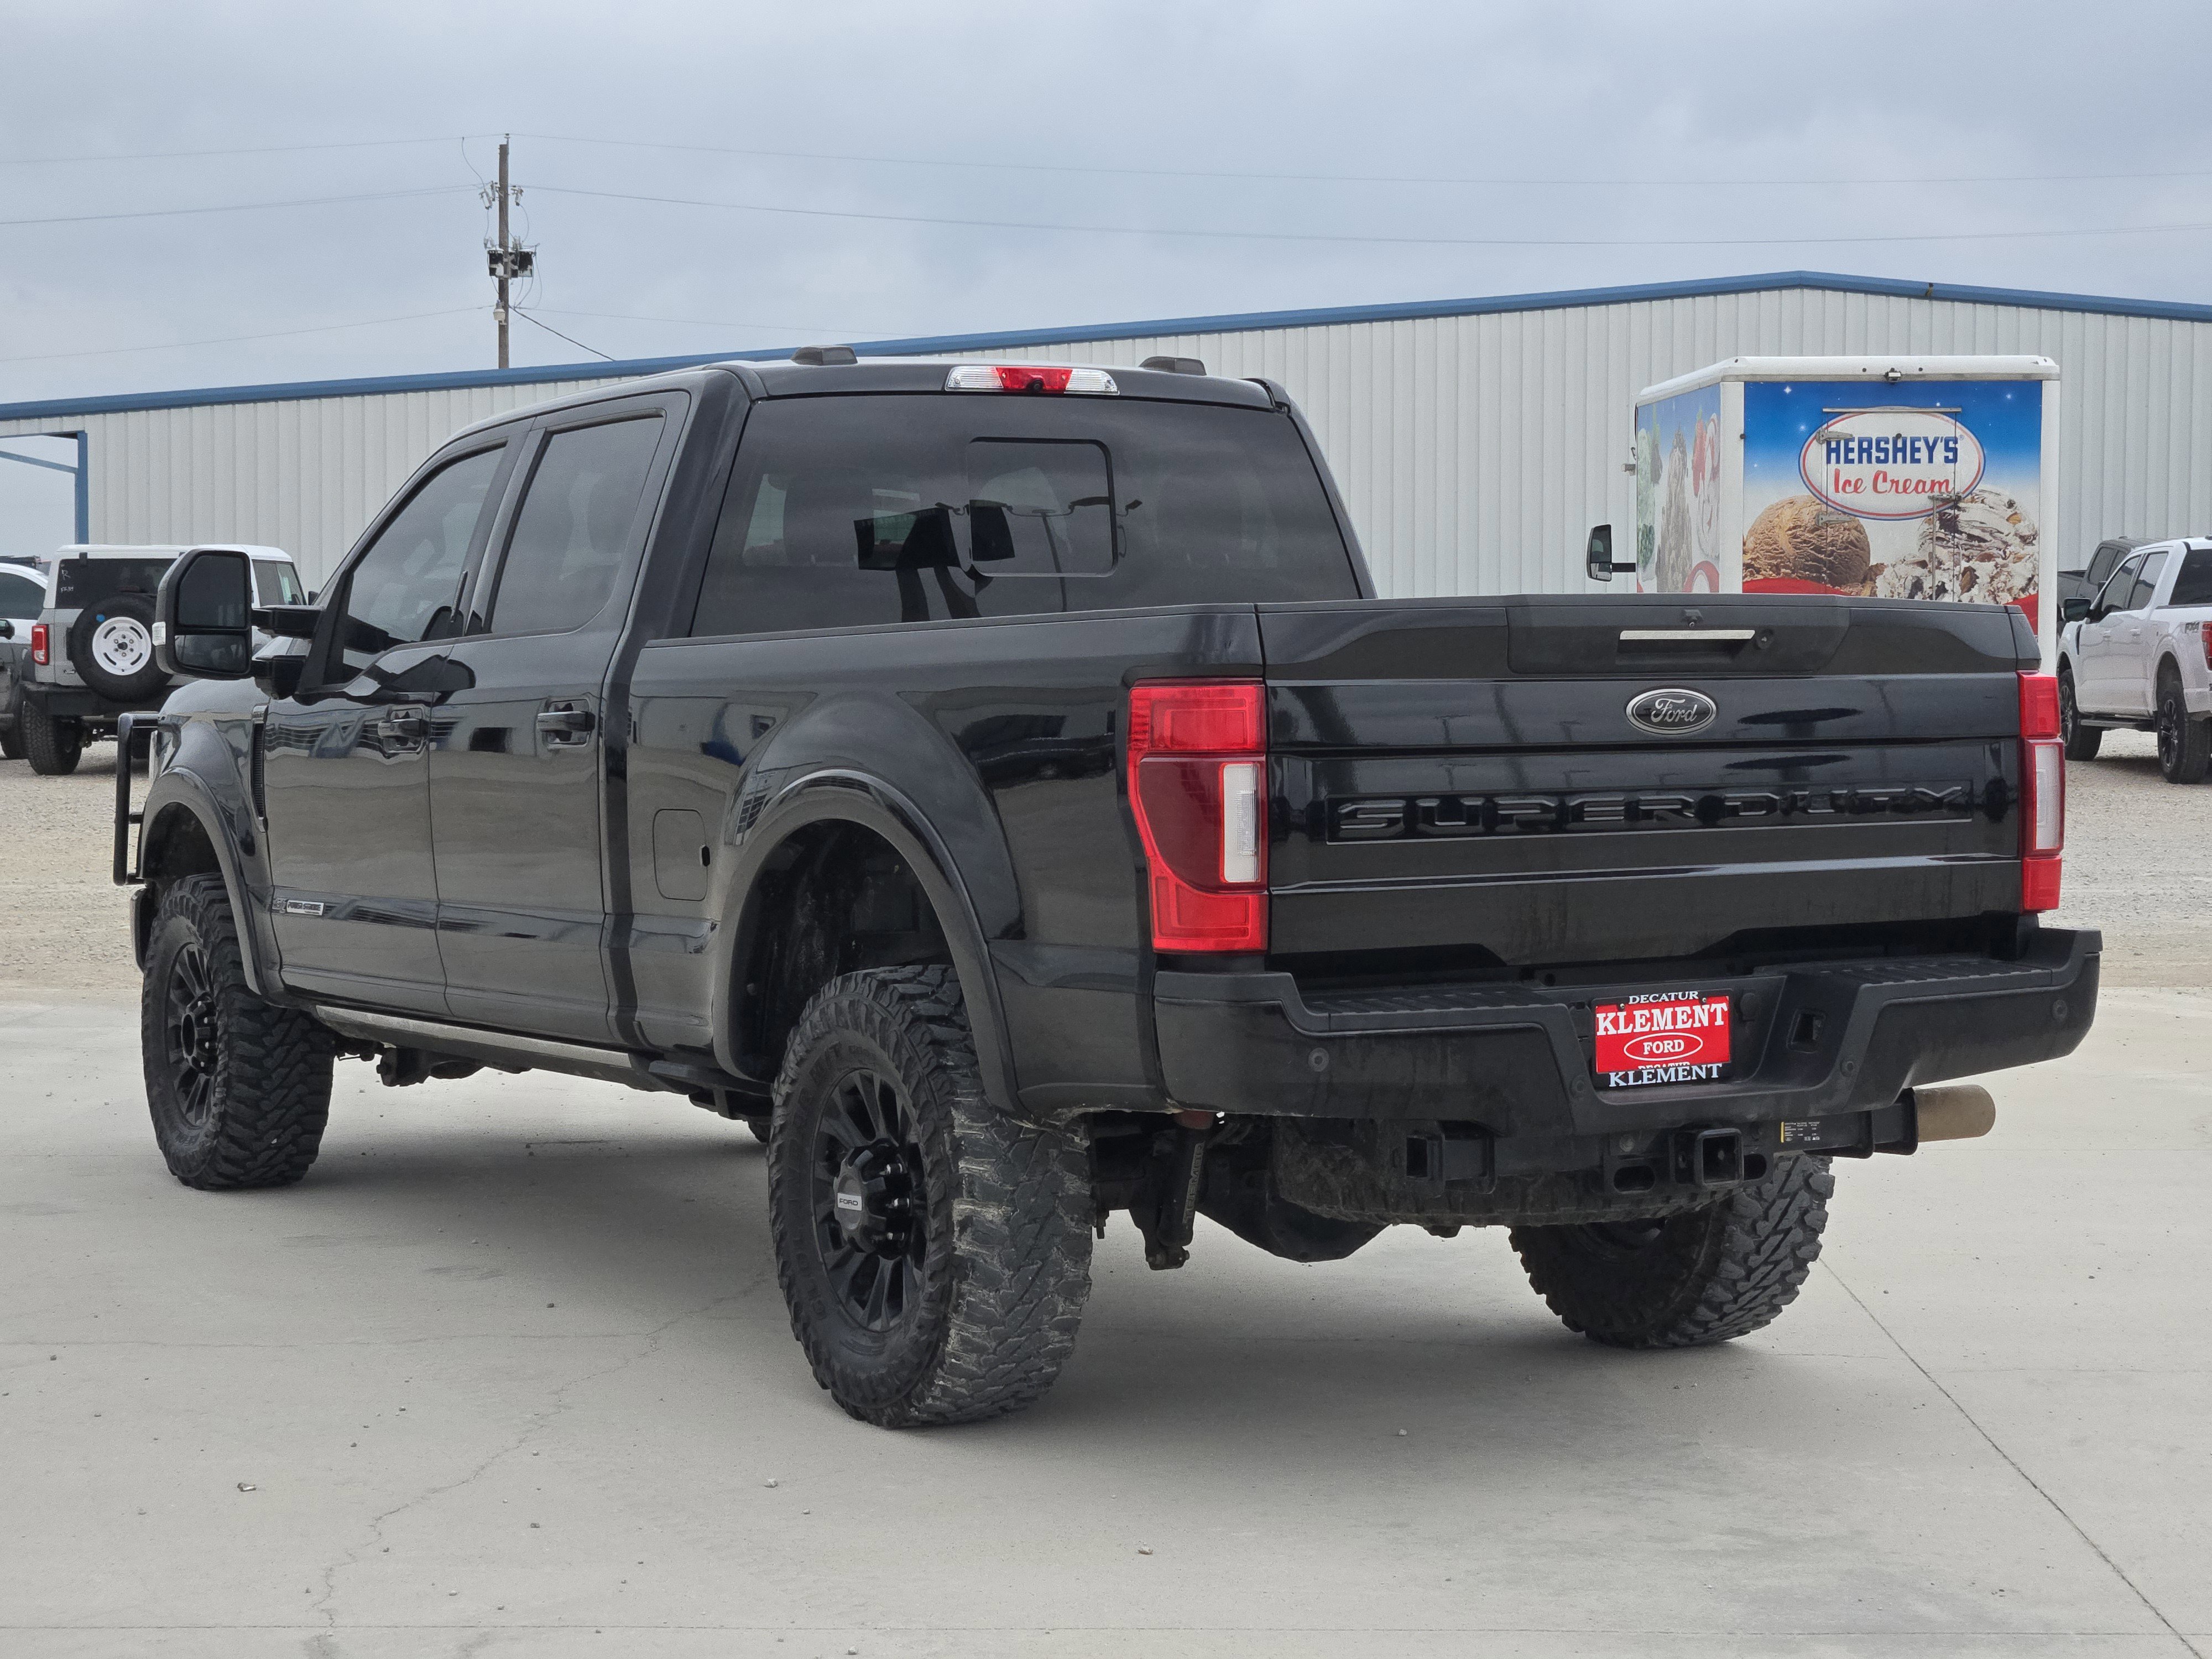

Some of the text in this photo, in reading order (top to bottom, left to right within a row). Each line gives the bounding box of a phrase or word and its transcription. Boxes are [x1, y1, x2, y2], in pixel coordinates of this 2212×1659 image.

[1826, 436, 1959, 465] HERSHEY'S
[1834, 468, 1954, 494] Ice Cream
[1651, 698, 1698, 723] Ford
[1337, 786, 1963, 838] SUPER DUTY
[1629, 991, 1699, 1005] DECATUR
[1596, 1003, 1728, 1036] KLEMENT
[1643, 1040, 1684, 1055] FORD
[1609, 1063, 1723, 1087] KLEMENT
[839, 1198, 858, 1206] FORD
